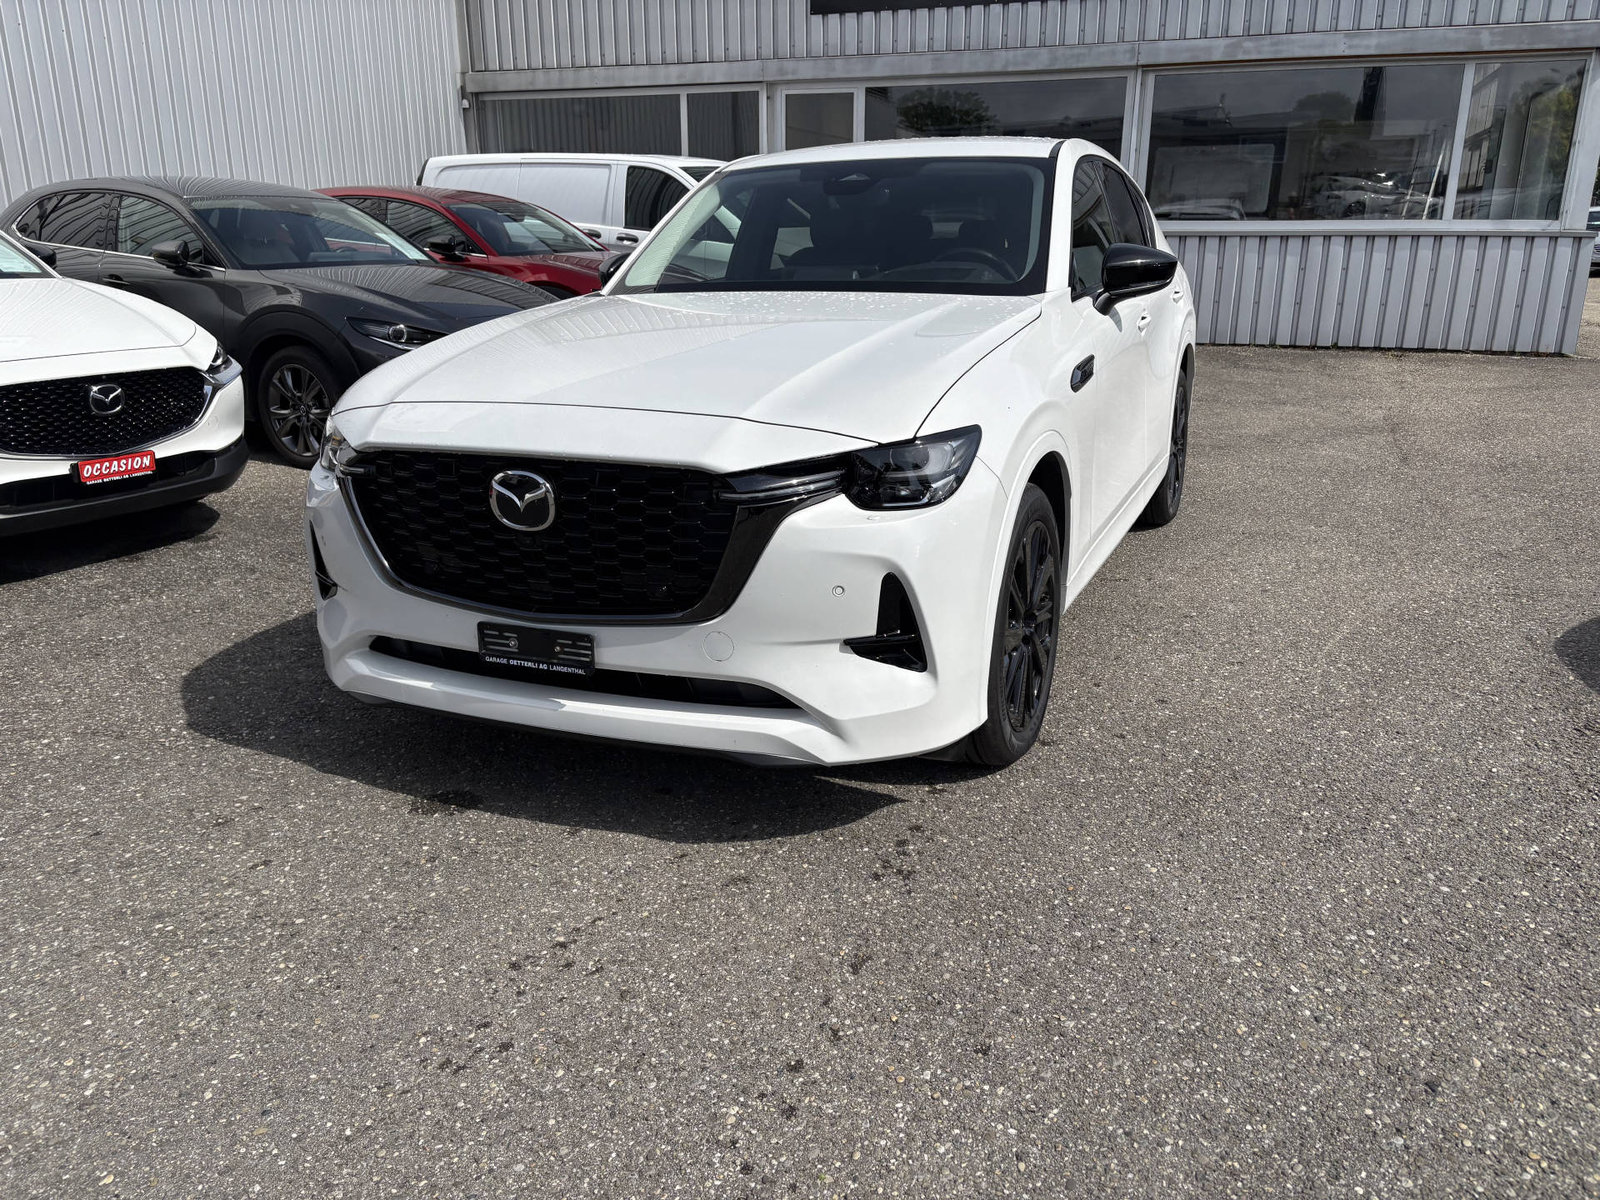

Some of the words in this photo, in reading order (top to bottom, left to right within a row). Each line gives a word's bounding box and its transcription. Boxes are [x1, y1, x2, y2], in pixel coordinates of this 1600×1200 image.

[83, 455, 151, 477] OCCASION
[485, 656, 508, 665] GARAGE
[549, 664, 586, 675] LANGENTHAL
